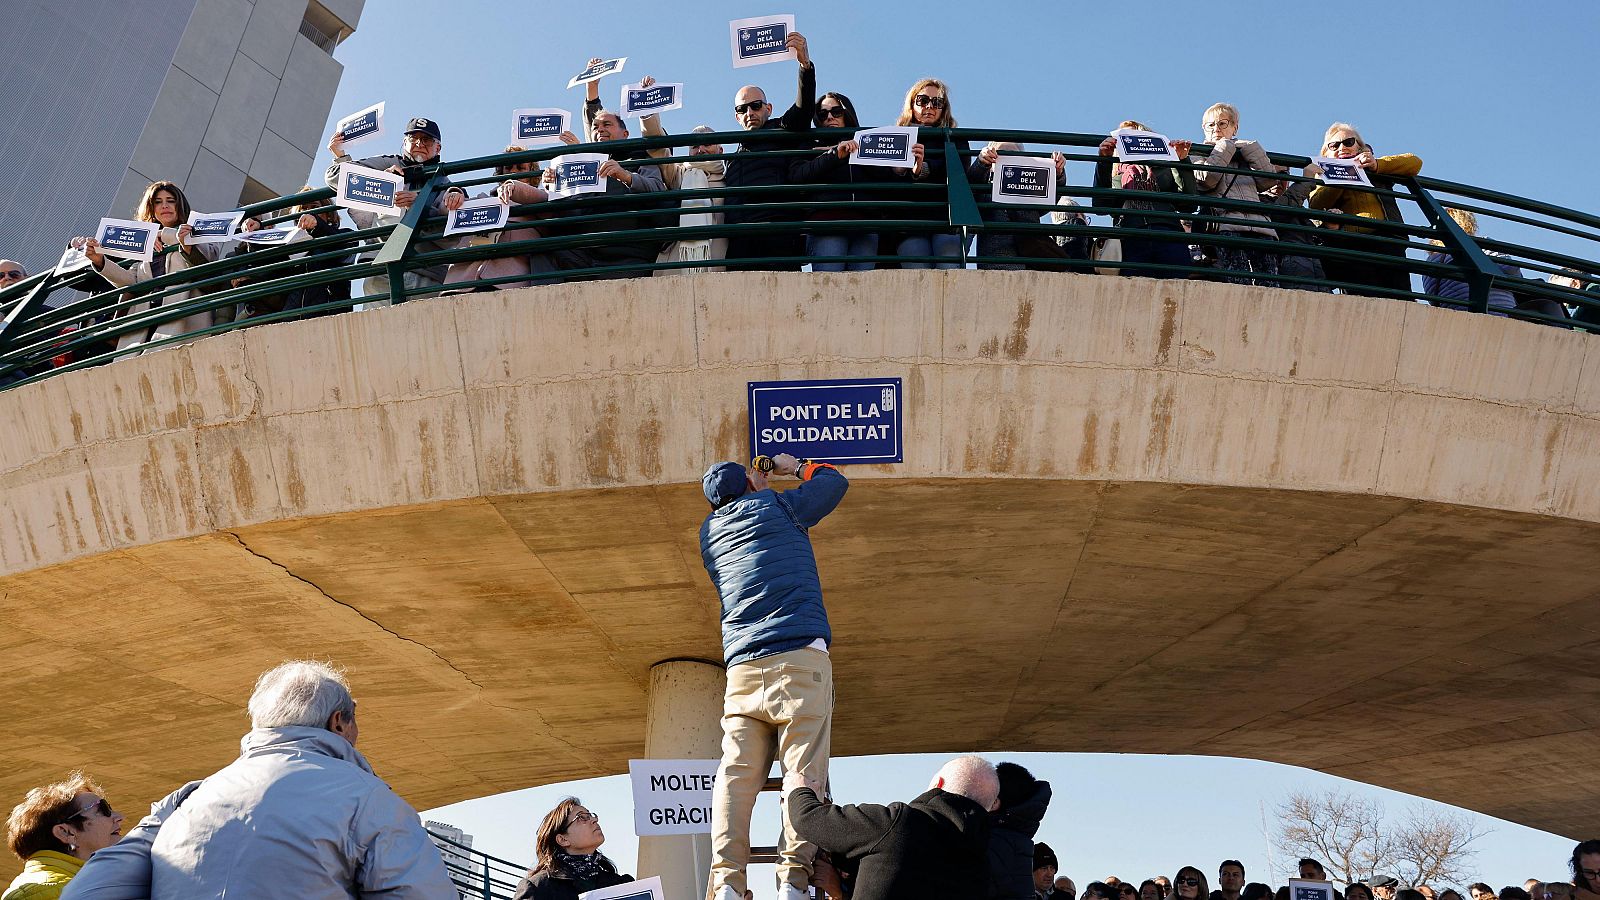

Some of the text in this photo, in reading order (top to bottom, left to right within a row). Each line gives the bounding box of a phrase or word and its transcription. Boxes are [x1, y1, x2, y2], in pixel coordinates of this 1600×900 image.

[746, 40, 783, 51] SOLIDARITAT
[634, 96, 670, 106] SOLIDARITAT
[416, 118, 428, 128] S
[352, 190, 390, 201] SOLIDARITAT
[106, 239, 142, 248] SOLIDARITAT
[770, 403, 880, 421] PONT DE LA
[761, 425, 890, 443] SOLIDARITAT
[650, 804, 712, 825] GRÀCI
